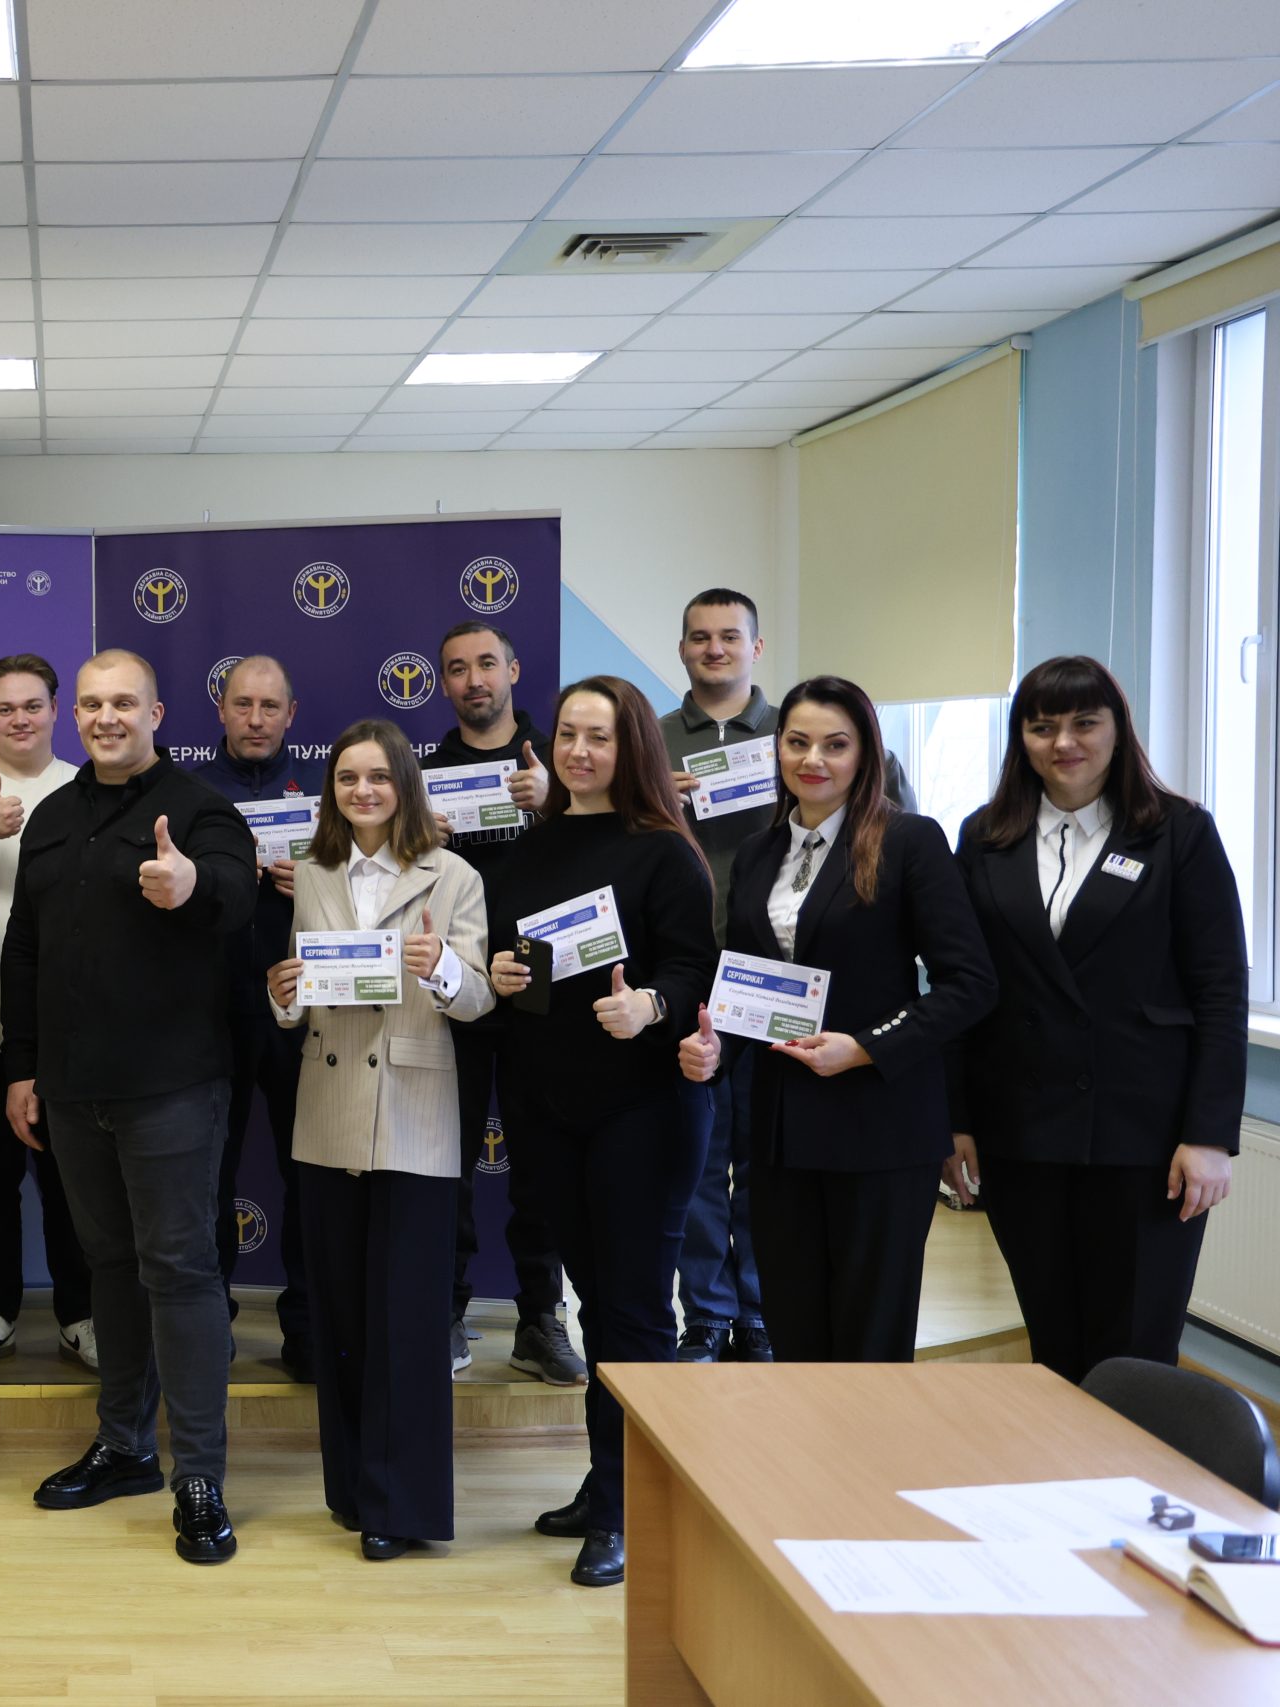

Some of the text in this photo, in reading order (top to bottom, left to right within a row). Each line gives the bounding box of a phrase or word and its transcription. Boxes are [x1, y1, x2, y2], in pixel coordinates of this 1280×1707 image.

[298, 565, 345, 585] ДЕРЖАВНА СЛУЖБА
[464, 560, 514, 580] ДЕРЖАВНА СЛУЖБА
[137, 571, 183, 591] ДЕРЖАВНА СЛУЖБА
[383, 656, 431, 676] ДЕРЖАВНА СЛУЖБА
[431, 781, 463, 792] СЕРТИФІКАТ
[246, 815, 275, 825] ЕРТИФІКАТ
[305, 948, 340, 957] СЕРТИФІКАТ
[726, 969, 765, 985] СЕРТИФІКАТ
[477, 1161, 509, 1171] АЙНЯТОСТІ
